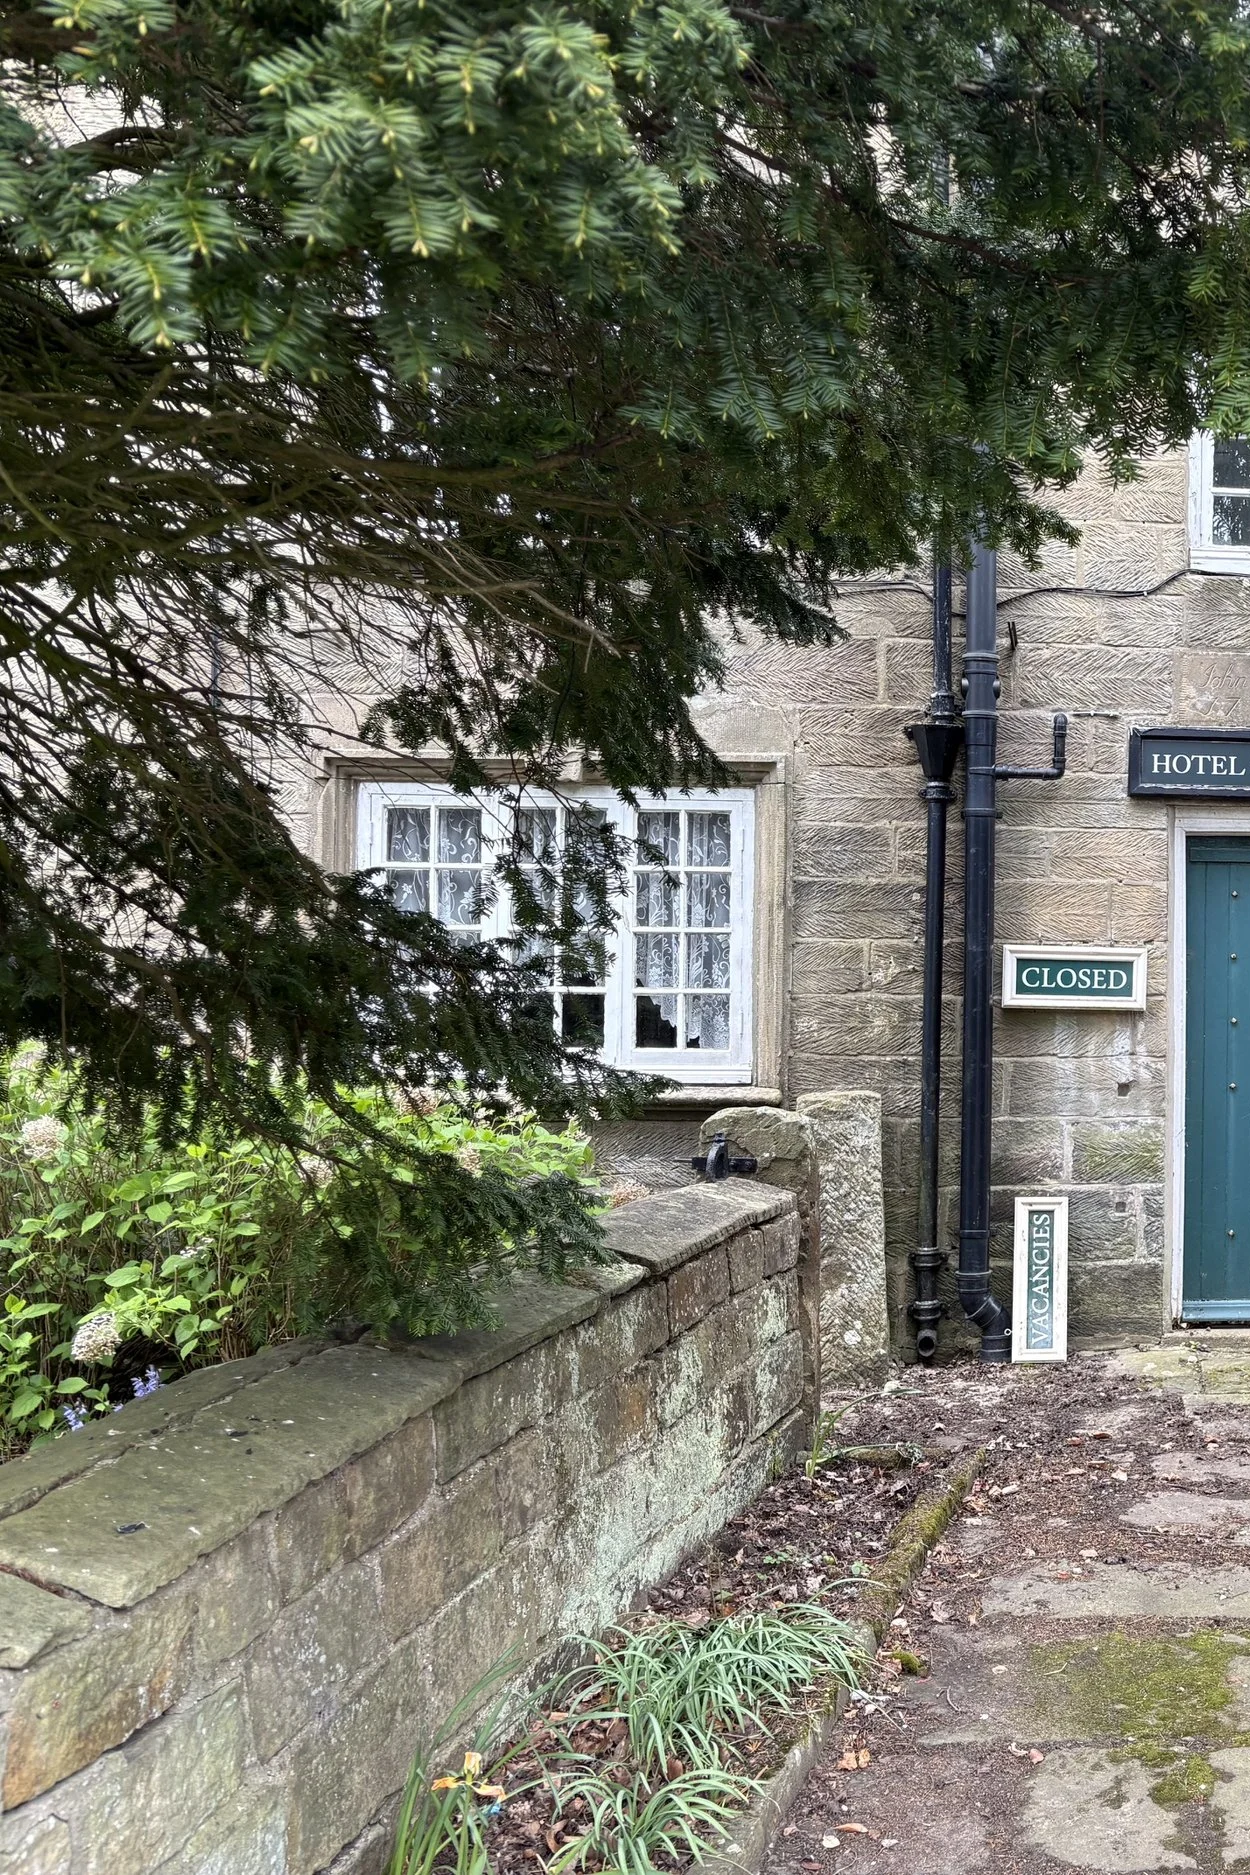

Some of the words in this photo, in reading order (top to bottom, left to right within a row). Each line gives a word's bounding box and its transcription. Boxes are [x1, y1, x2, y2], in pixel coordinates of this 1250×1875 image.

[1200, 662, 1247, 689] John
[1151, 753, 1247, 776] HOTEL
[1021, 967, 1128, 989] CLOSED
[1031, 1213, 1050, 1345] VACANCIES
